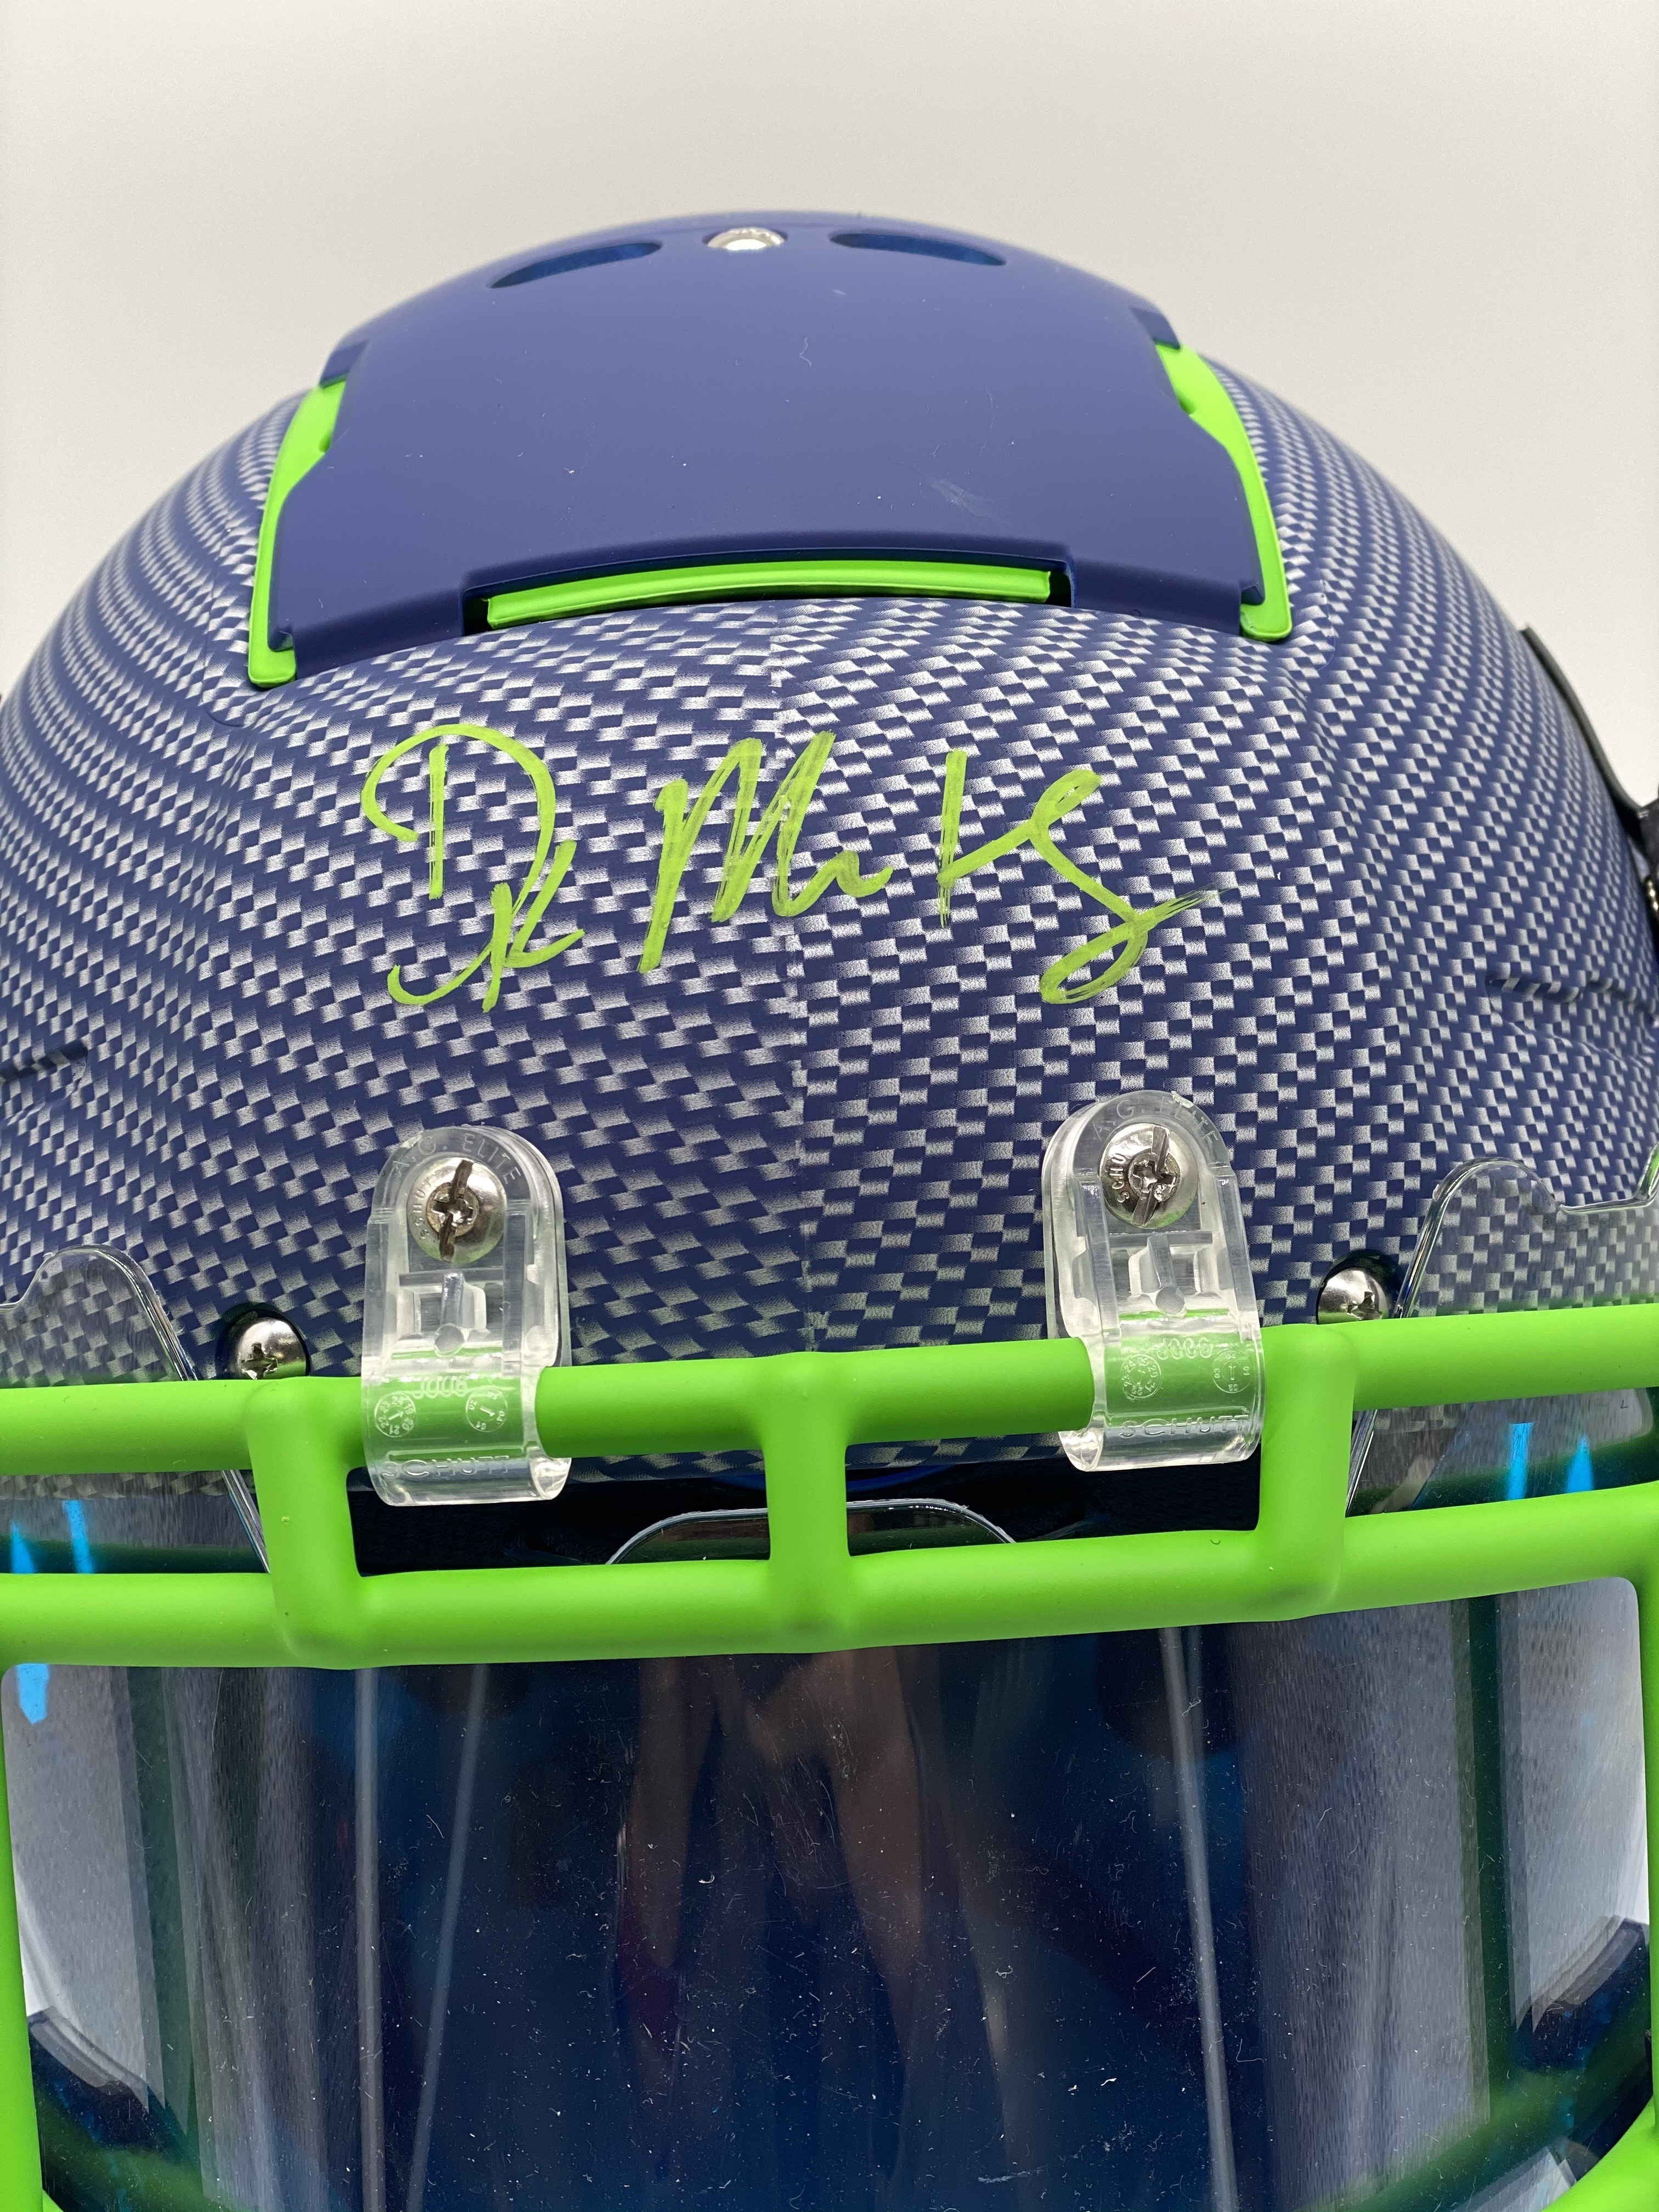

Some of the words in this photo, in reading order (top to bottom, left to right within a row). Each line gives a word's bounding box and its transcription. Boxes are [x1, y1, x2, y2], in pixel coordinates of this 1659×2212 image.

[1159, 1096, 1219, 1147] ELITE
[462, 1132, 522, 1186] ELITE
[1119, 1414, 1249, 1438] SCHUTT
[380, 1455, 510, 1479] SCHUTT
